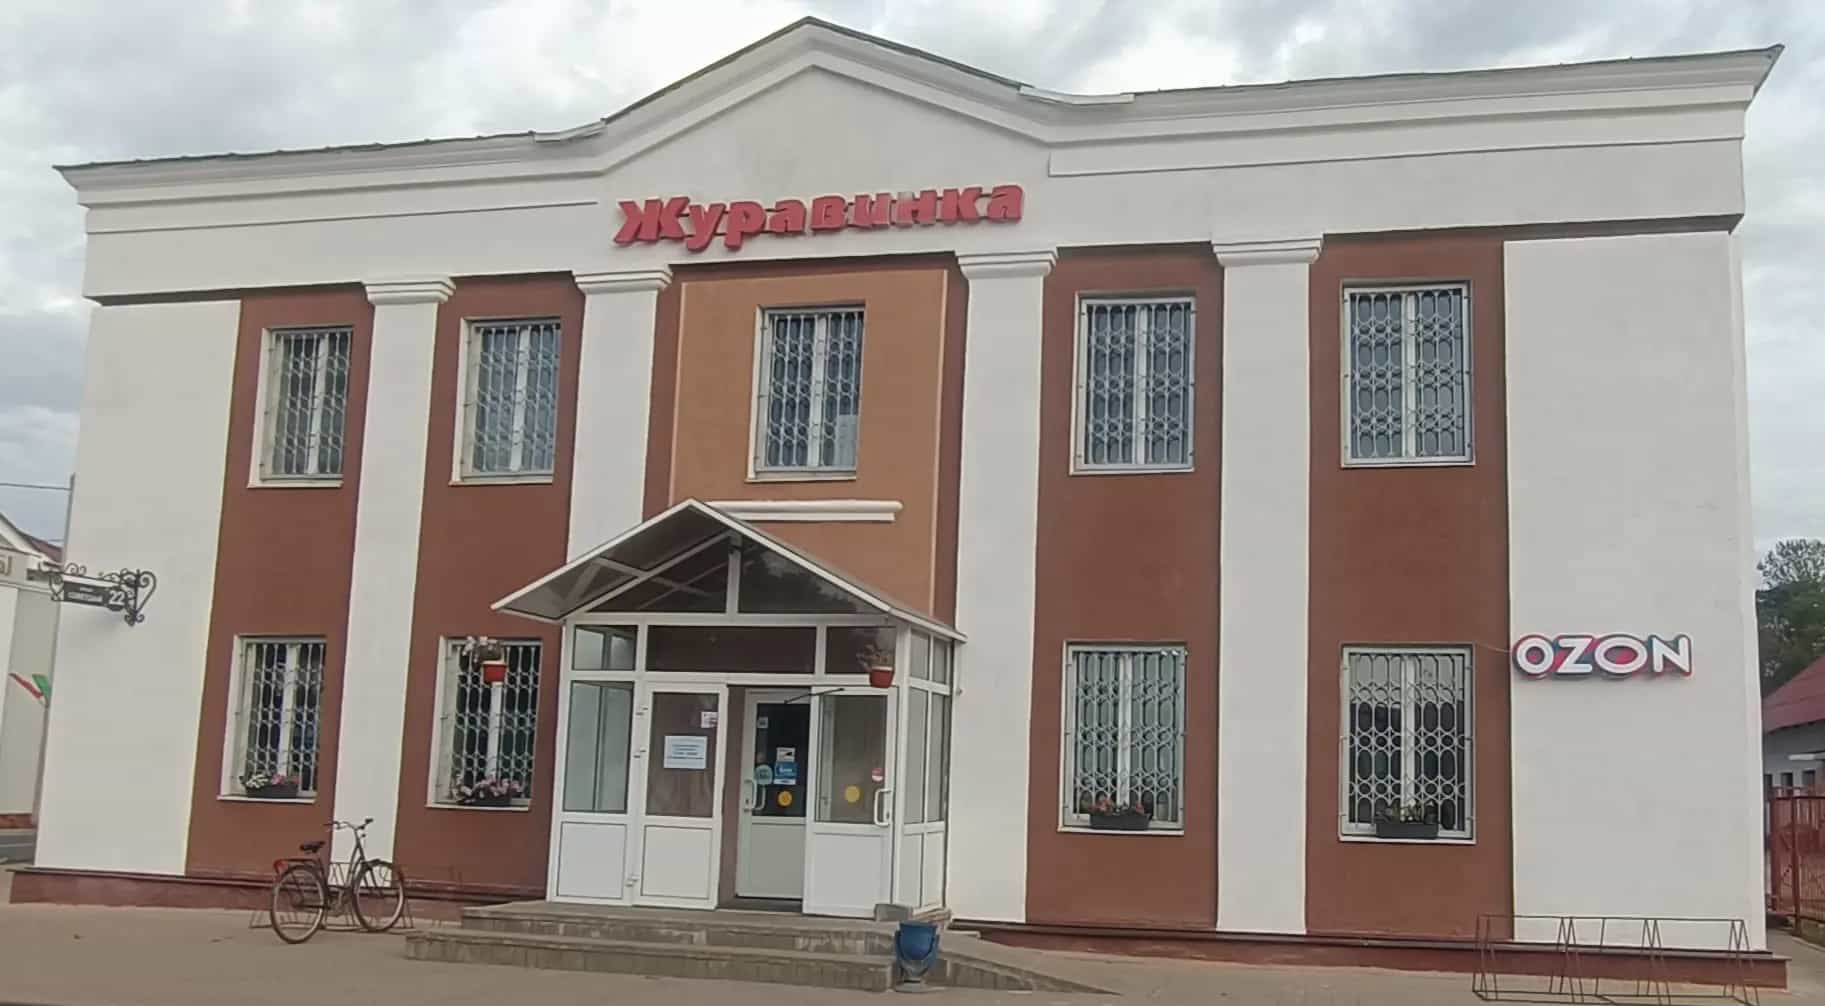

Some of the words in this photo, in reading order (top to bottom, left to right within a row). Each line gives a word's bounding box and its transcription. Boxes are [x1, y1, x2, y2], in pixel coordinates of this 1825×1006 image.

[614, 184, 1023, 252] Журавинка
[109, 590, 125, 606] 22
[1513, 634, 1692, 677] OZON
